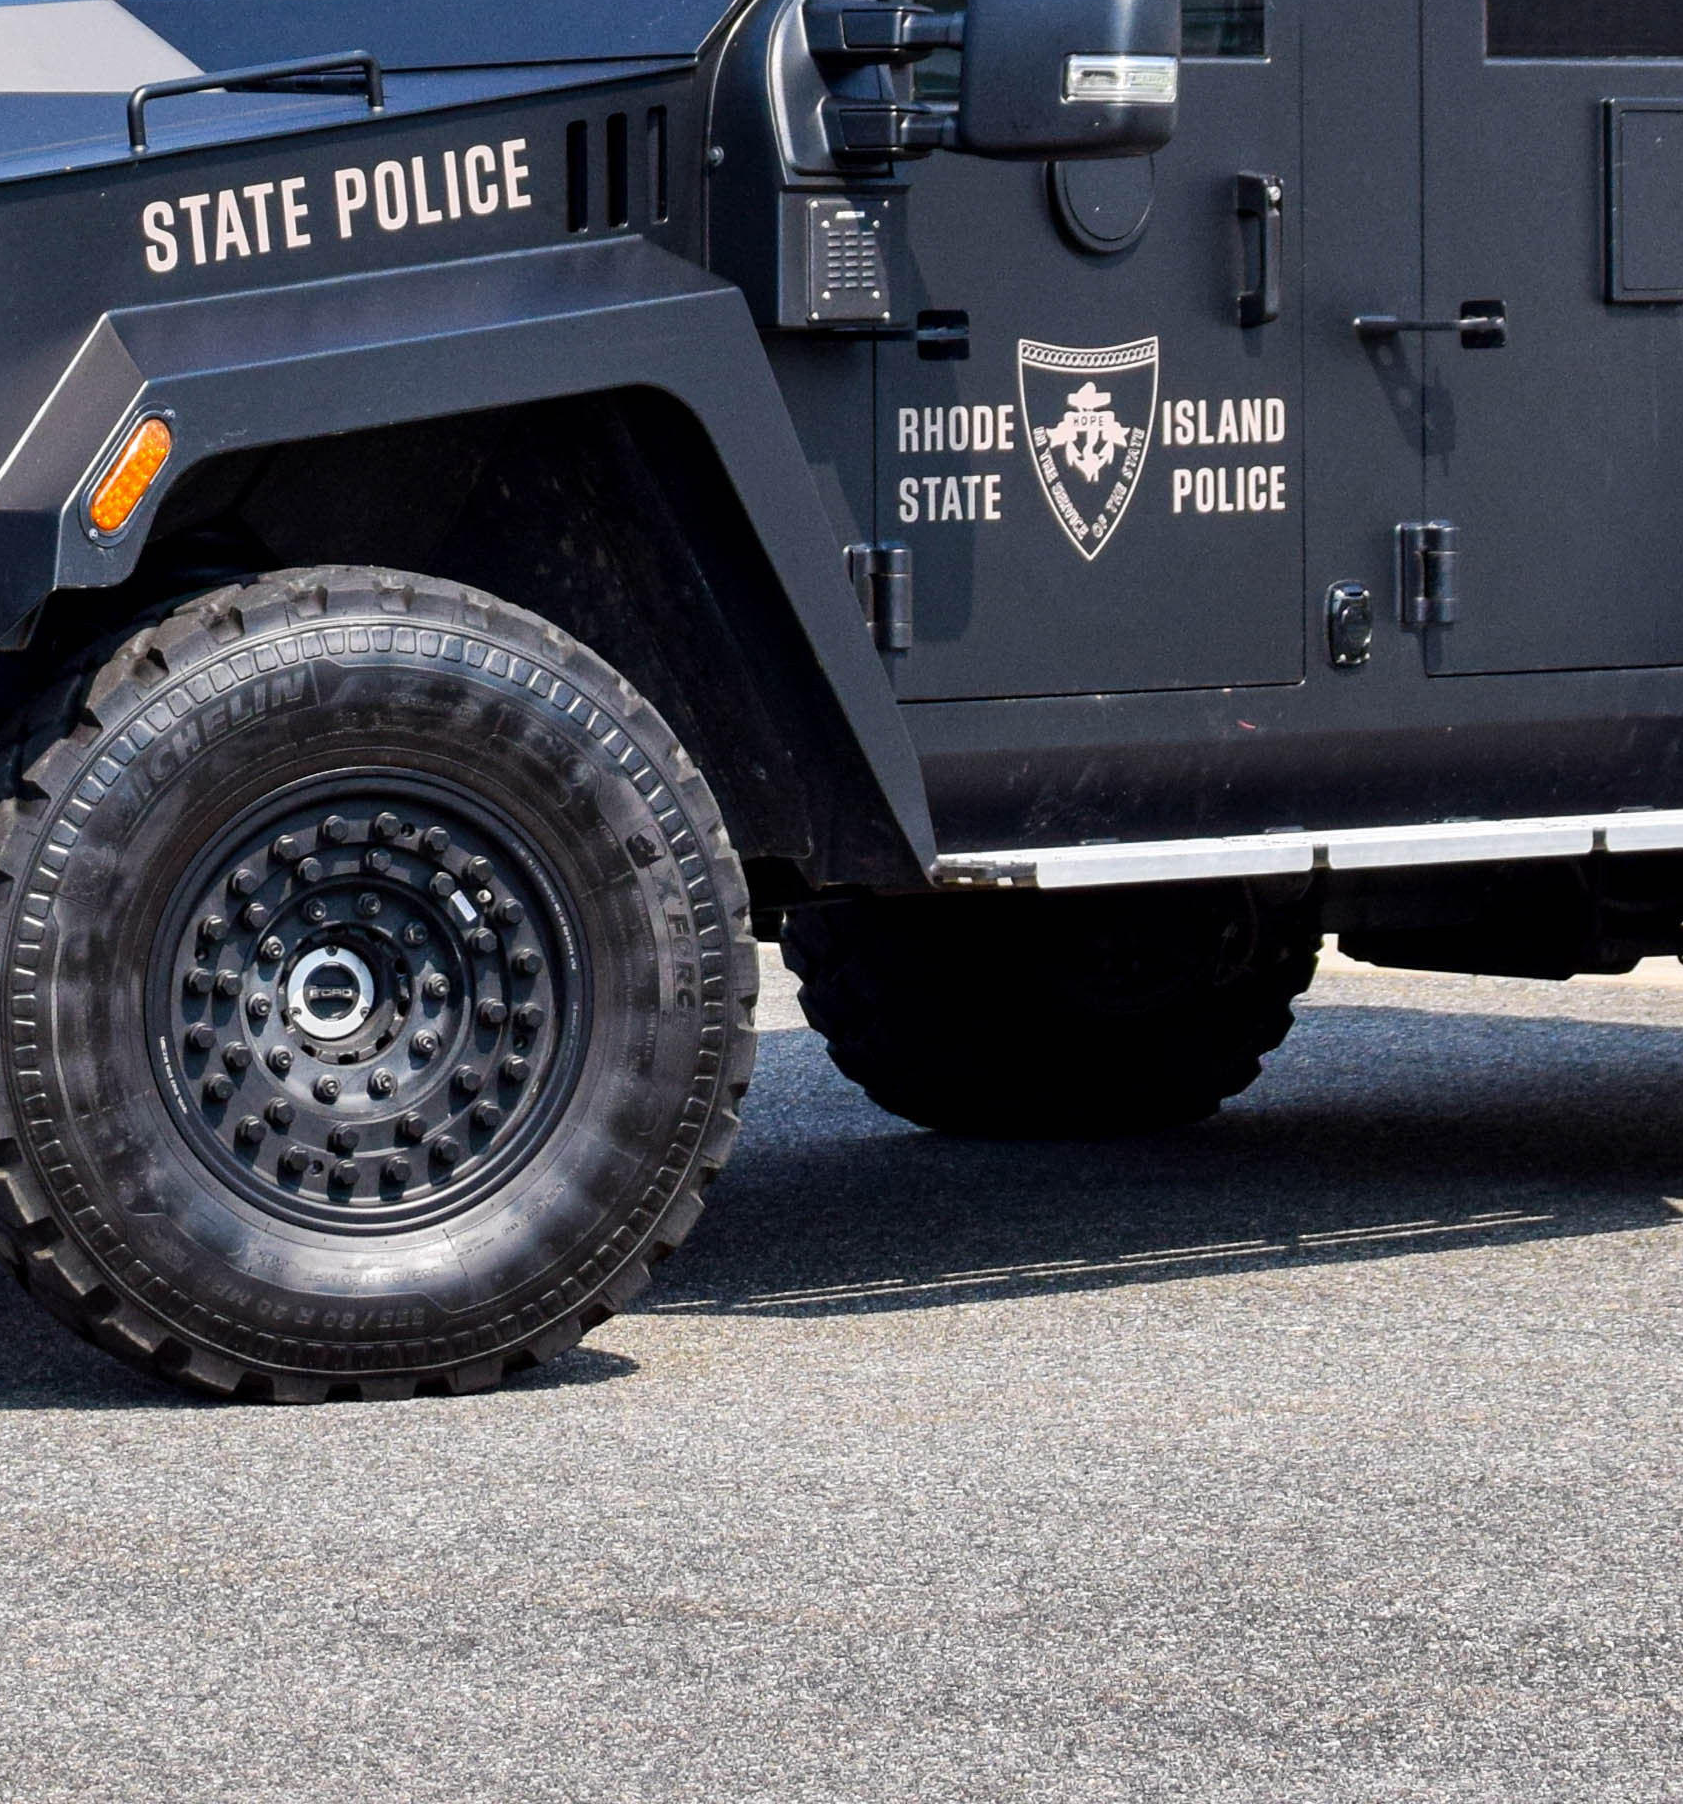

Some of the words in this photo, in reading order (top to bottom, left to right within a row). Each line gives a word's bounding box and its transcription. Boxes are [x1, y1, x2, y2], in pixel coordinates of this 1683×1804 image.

[142, 176, 312, 274] STATE
[334, 138, 532, 238] POLICE
[898, 404, 1014, 452] RHODE
[1162, 397, 1285, 445] ISLAND
[1032, 426, 1048, 447] IN
[1073, 414, 1104, 427] HOPE
[1038, 447, 1059, 483] THE
[1121, 426, 1146, 480] STATE
[898, 475, 1001, 523] STATE
[1172, 465, 1286, 513] POLICE
[1105, 480, 1128, 514] THE
[1091, 513, 1108, 539] OF
[119, 671, 306, 806] ICHELIN
[309, 988, 353, 997] FORD
